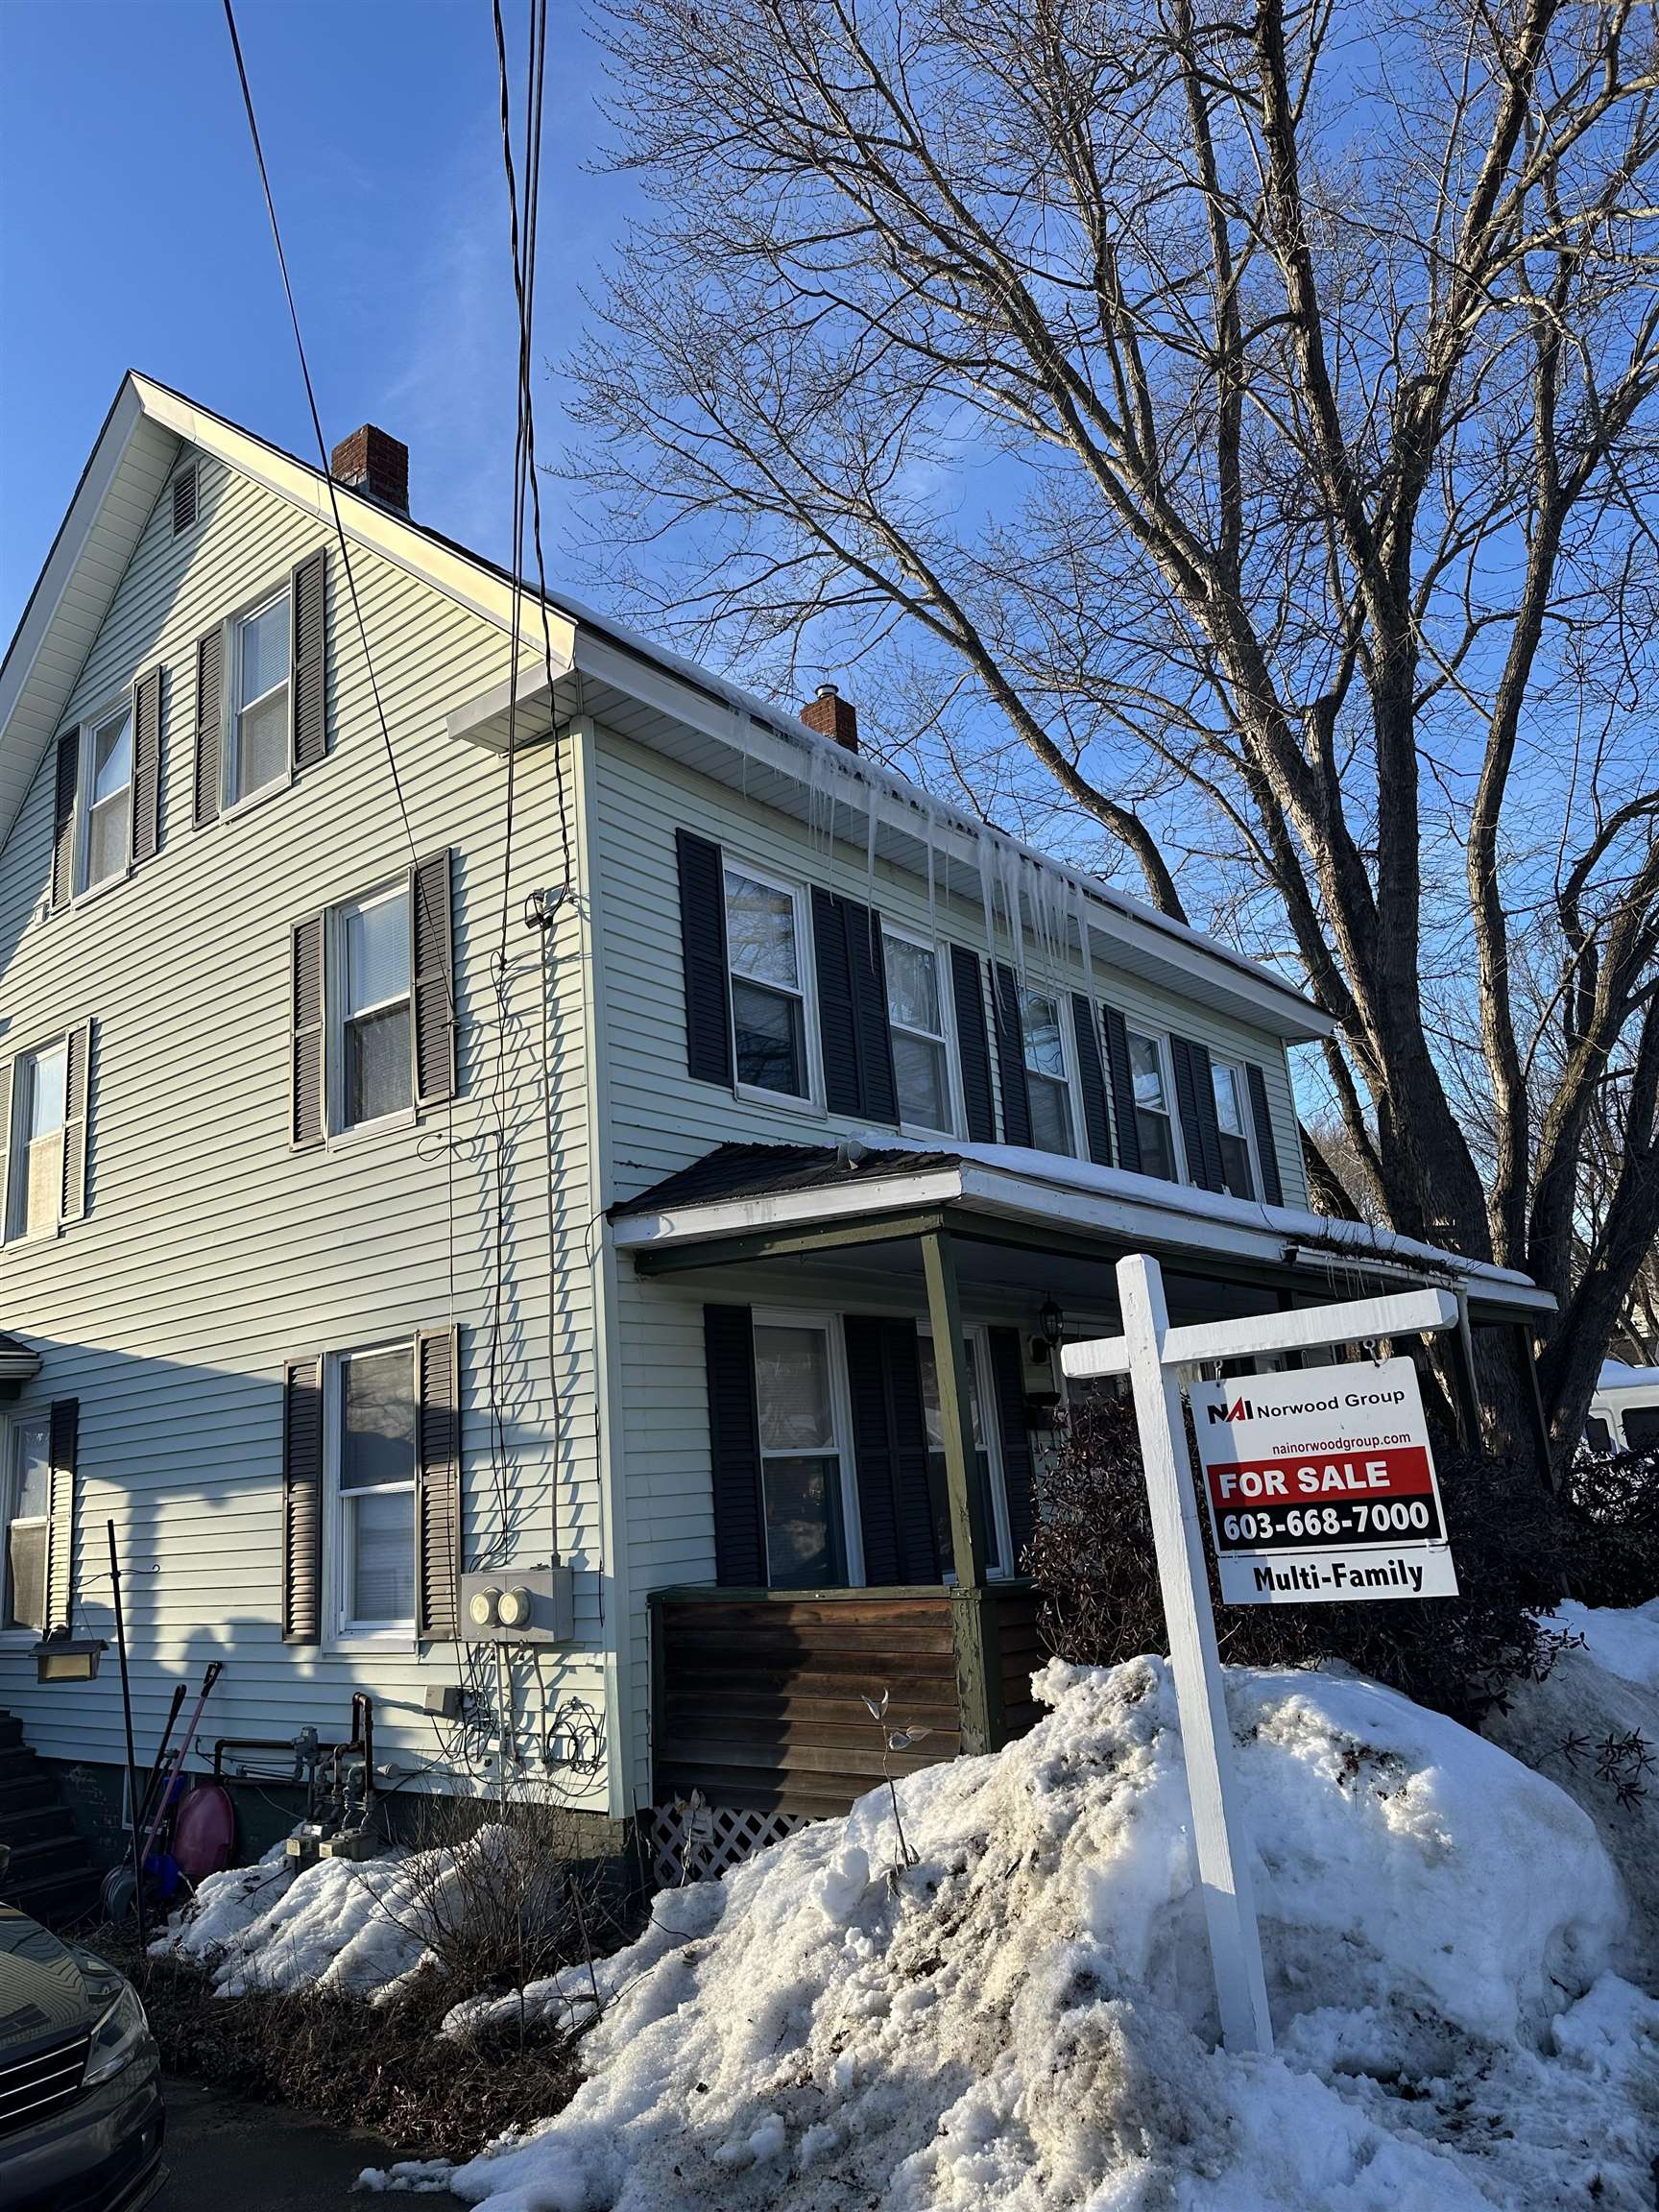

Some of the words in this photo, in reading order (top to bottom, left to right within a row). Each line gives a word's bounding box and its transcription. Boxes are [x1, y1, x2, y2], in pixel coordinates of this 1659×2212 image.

[1207, 1396, 1254, 1425] NAI
[1257, 1395, 1339, 1419] Norwood
[1344, 1389, 1406, 1408] Group
[1272, 1432, 1411, 1455] nainorwoodgroup.com
[1218, 1469, 1288, 1499] FOR
[1296, 1460, 1390, 1493] SALE
[1223, 1501, 1430, 1542] 603-668-7000
[1253, 1558, 1423, 1592] Multi-Family
